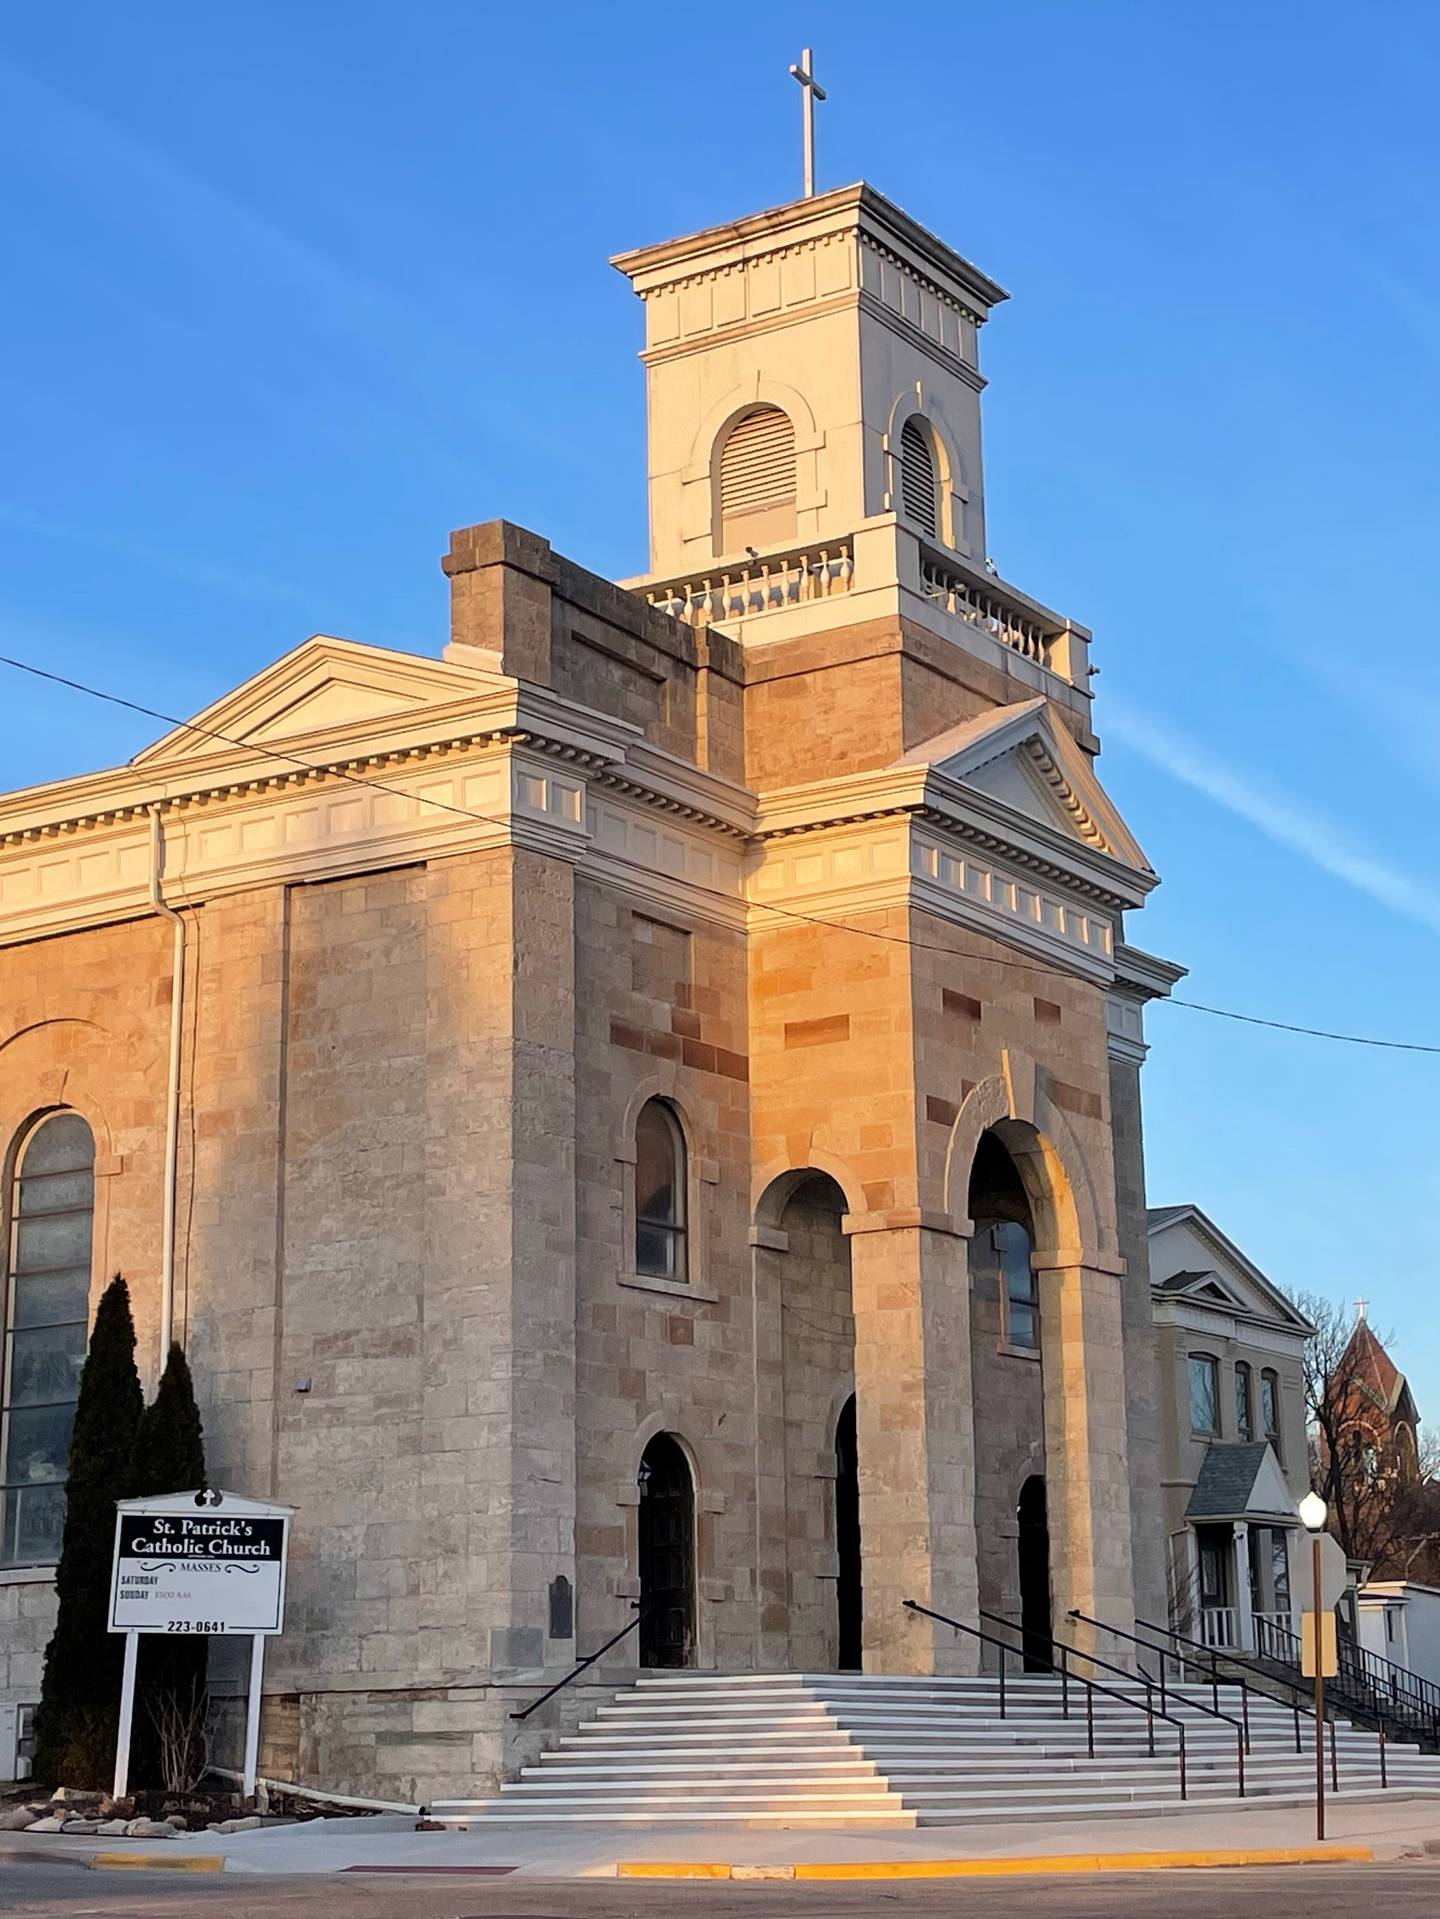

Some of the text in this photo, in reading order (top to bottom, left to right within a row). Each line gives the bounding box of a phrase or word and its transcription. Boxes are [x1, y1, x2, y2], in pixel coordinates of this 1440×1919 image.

[153, 1519, 253, 1536] St. Patrick's
[131, 1538, 271, 1555] Catholic Church
[179, 1563, 221, 1572] MASSES
[121, 1576, 158, 1585] SATURDAY
[120, 1590, 149, 1599] SUNDAY
[168, 1621, 225, 1632] 223-0641
